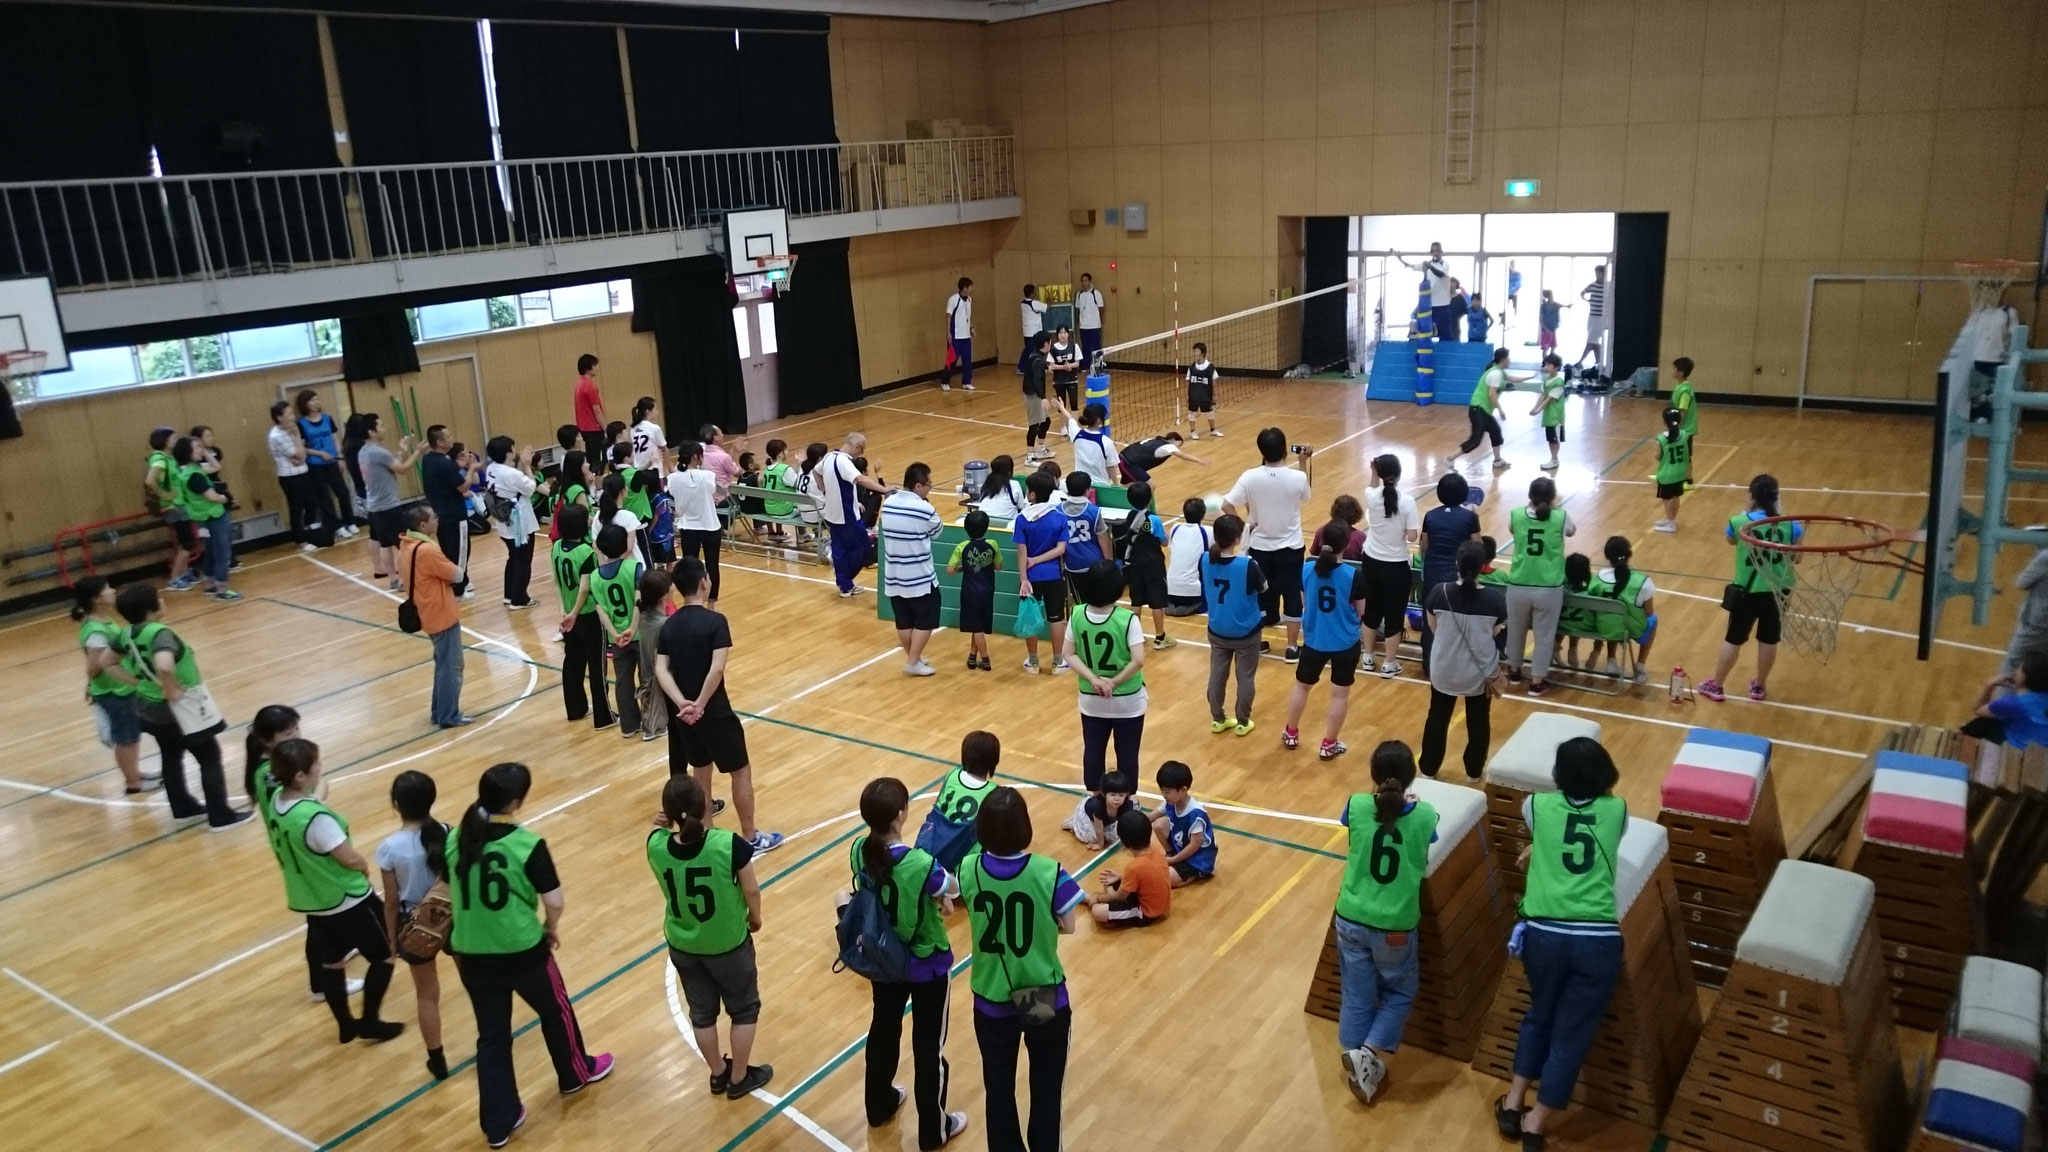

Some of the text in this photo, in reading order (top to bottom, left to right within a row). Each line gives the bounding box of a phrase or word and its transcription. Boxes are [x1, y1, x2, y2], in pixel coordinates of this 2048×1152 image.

[633, 435, 649, 453] 32
[1668, 445, 1684, 464] 15
[1067, 520, 1091, 543] 23
[1527, 529, 1544, 556] 5
[554, 558, 576, 592] 10
[607, 584, 629, 617] 9
[1213, 579, 1231, 604] 7
[1318, 586, 1336, 613] 6
[1081, 630, 1118, 671] 12
[1518, 823, 1526, 834] 2
[1370, 826, 1402, 884] 6
[1562, 813, 1597, 875] 5
[1695, 851, 1706, 864] 2
[458, 851, 510, 912] 16
[663, 866, 716, 923] 15
[1693, 891, 1703, 902] 4
[974, 890, 1035, 958] 20
[1692, 910, 1702, 922] 5
[1897, 946, 1908, 959] 5
[1779, 989, 1788, 1009] 1
[1771, 1014, 1789, 1035] 2
[1767, 1062, 1783, 1081] 4
[1763, 1106, 1780, 1126] 6
